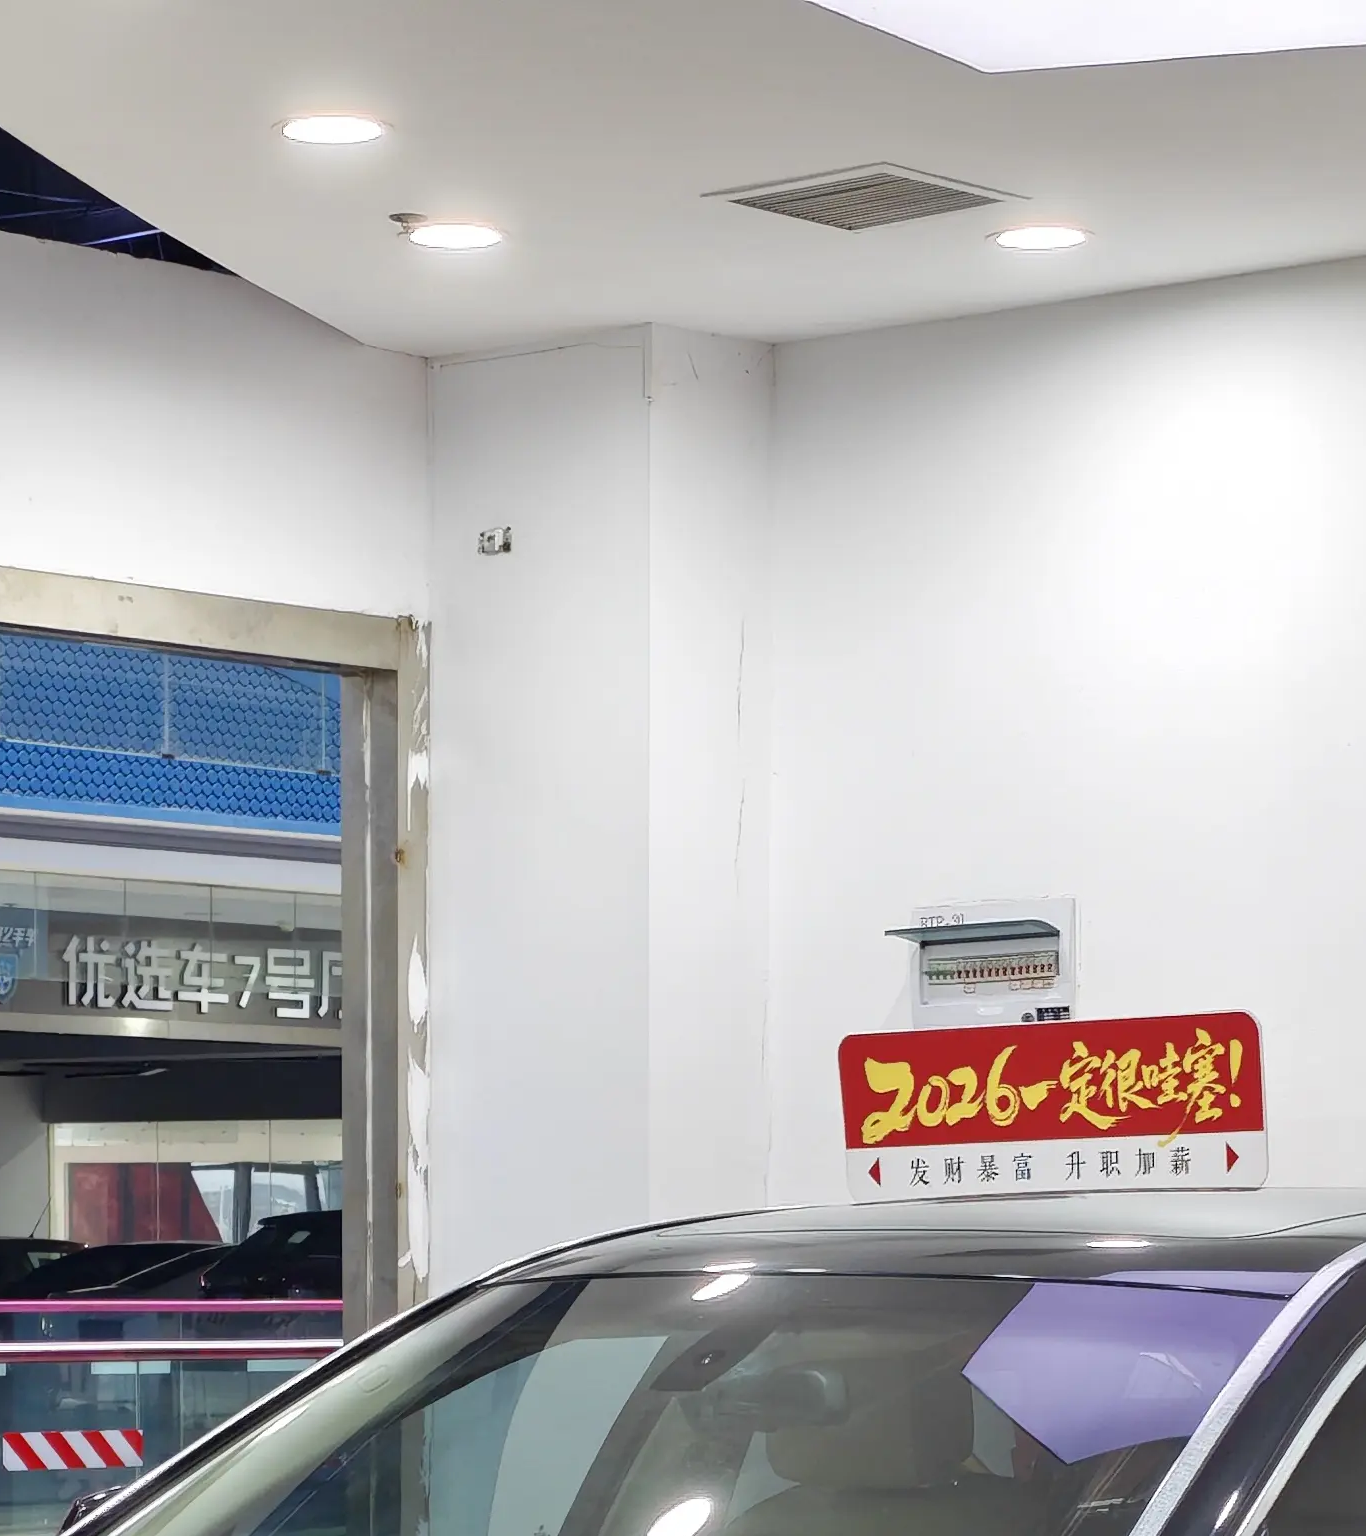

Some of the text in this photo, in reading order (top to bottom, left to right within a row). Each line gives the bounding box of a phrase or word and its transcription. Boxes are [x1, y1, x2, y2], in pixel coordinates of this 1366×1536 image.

[909, 1147, 1191, 1187] 发财暴富 升职加薪
